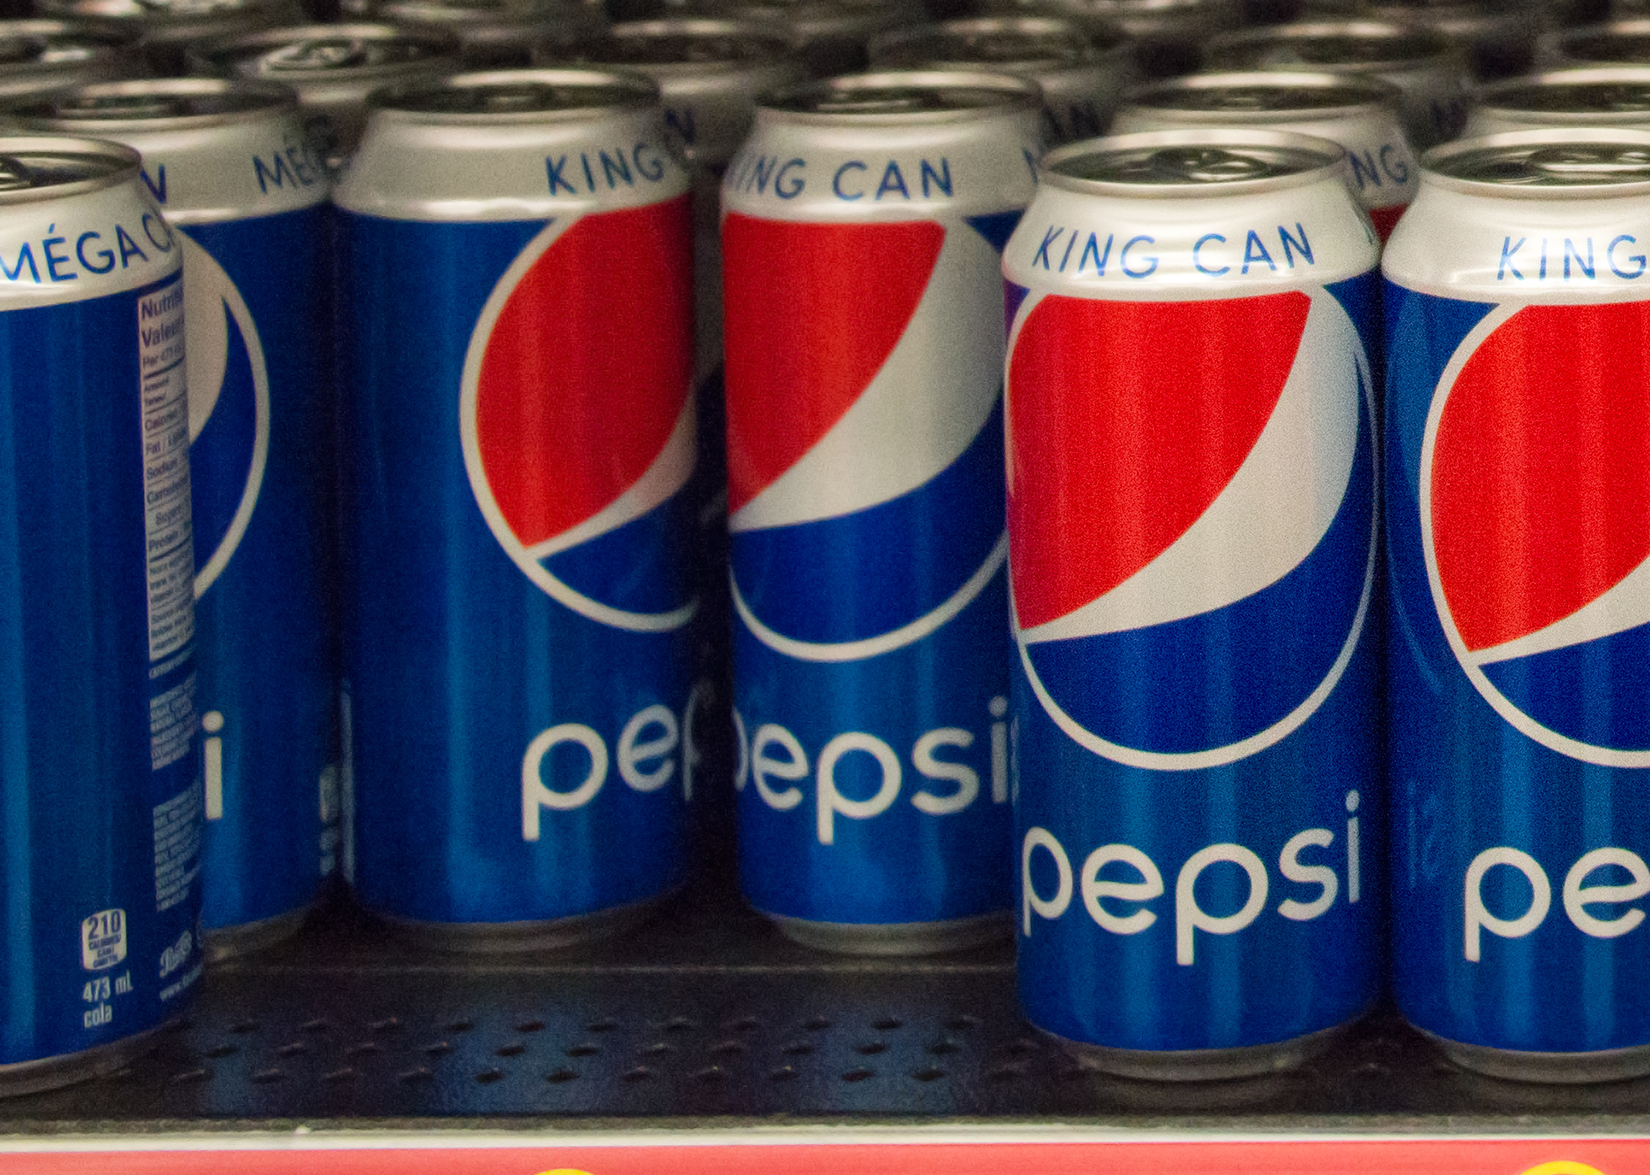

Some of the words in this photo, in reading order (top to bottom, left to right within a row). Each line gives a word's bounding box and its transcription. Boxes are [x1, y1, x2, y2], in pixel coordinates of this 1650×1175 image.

[546, 145, 665, 198] KING
[831, 157, 955, 202] CAN
[0, 222, 149, 284] MÉGA
[1031, 224, 1160, 280] KING
[1191, 221, 1317, 279] CAN
[1495, 233, 1649, 283] KING
[1021, 789, 1361, 967] pepsi
[88, 910, 121, 940] 210
[83, 976, 111, 1003] 473
[84, 1001, 113, 1029] cola
